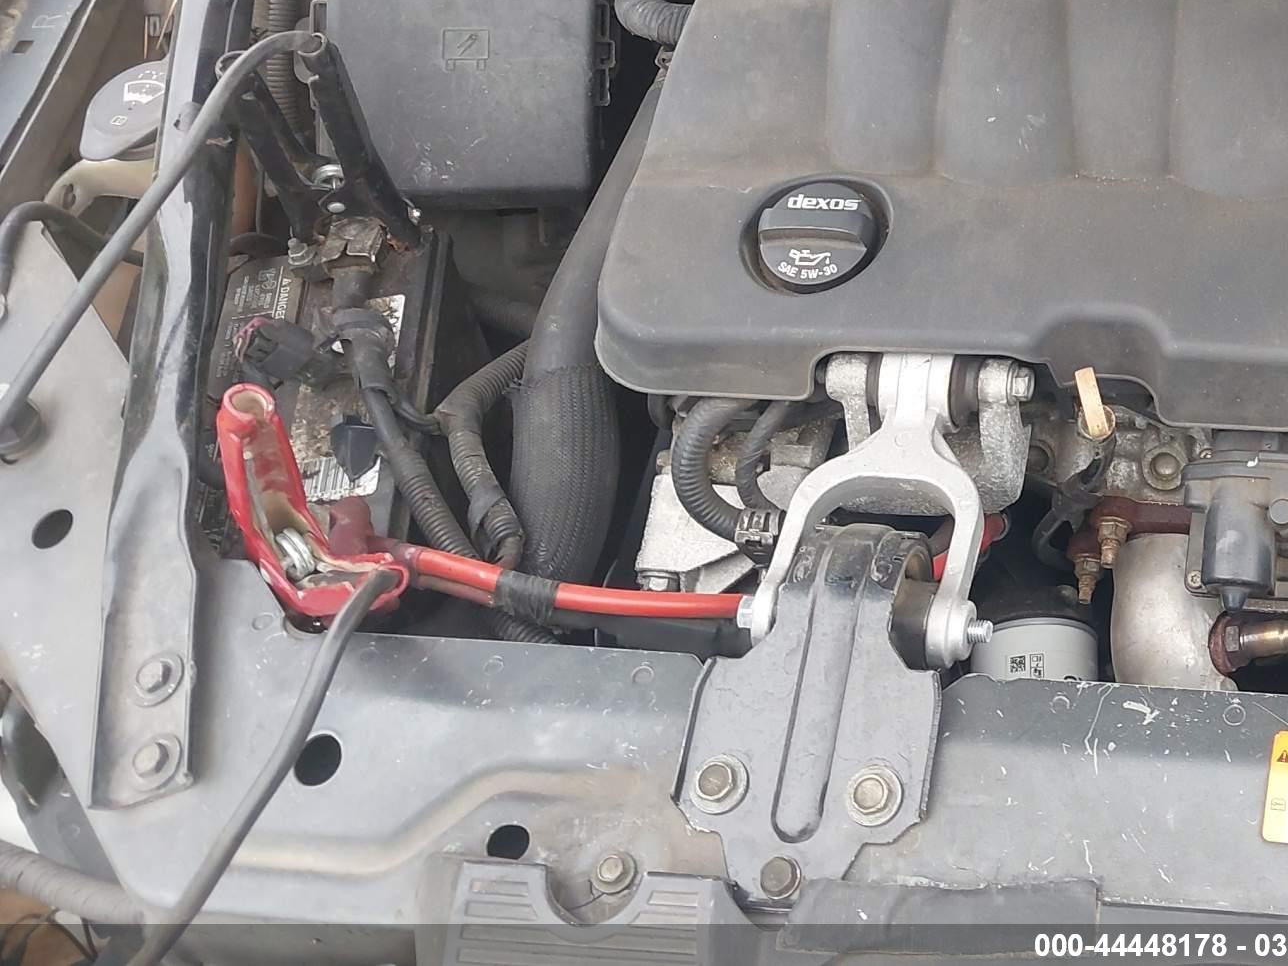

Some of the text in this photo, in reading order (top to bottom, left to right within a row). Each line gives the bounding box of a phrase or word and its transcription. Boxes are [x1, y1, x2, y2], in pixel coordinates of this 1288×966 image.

[787, 193, 862, 211] dexos
[777, 261, 838, 280] SAE 5W-30
